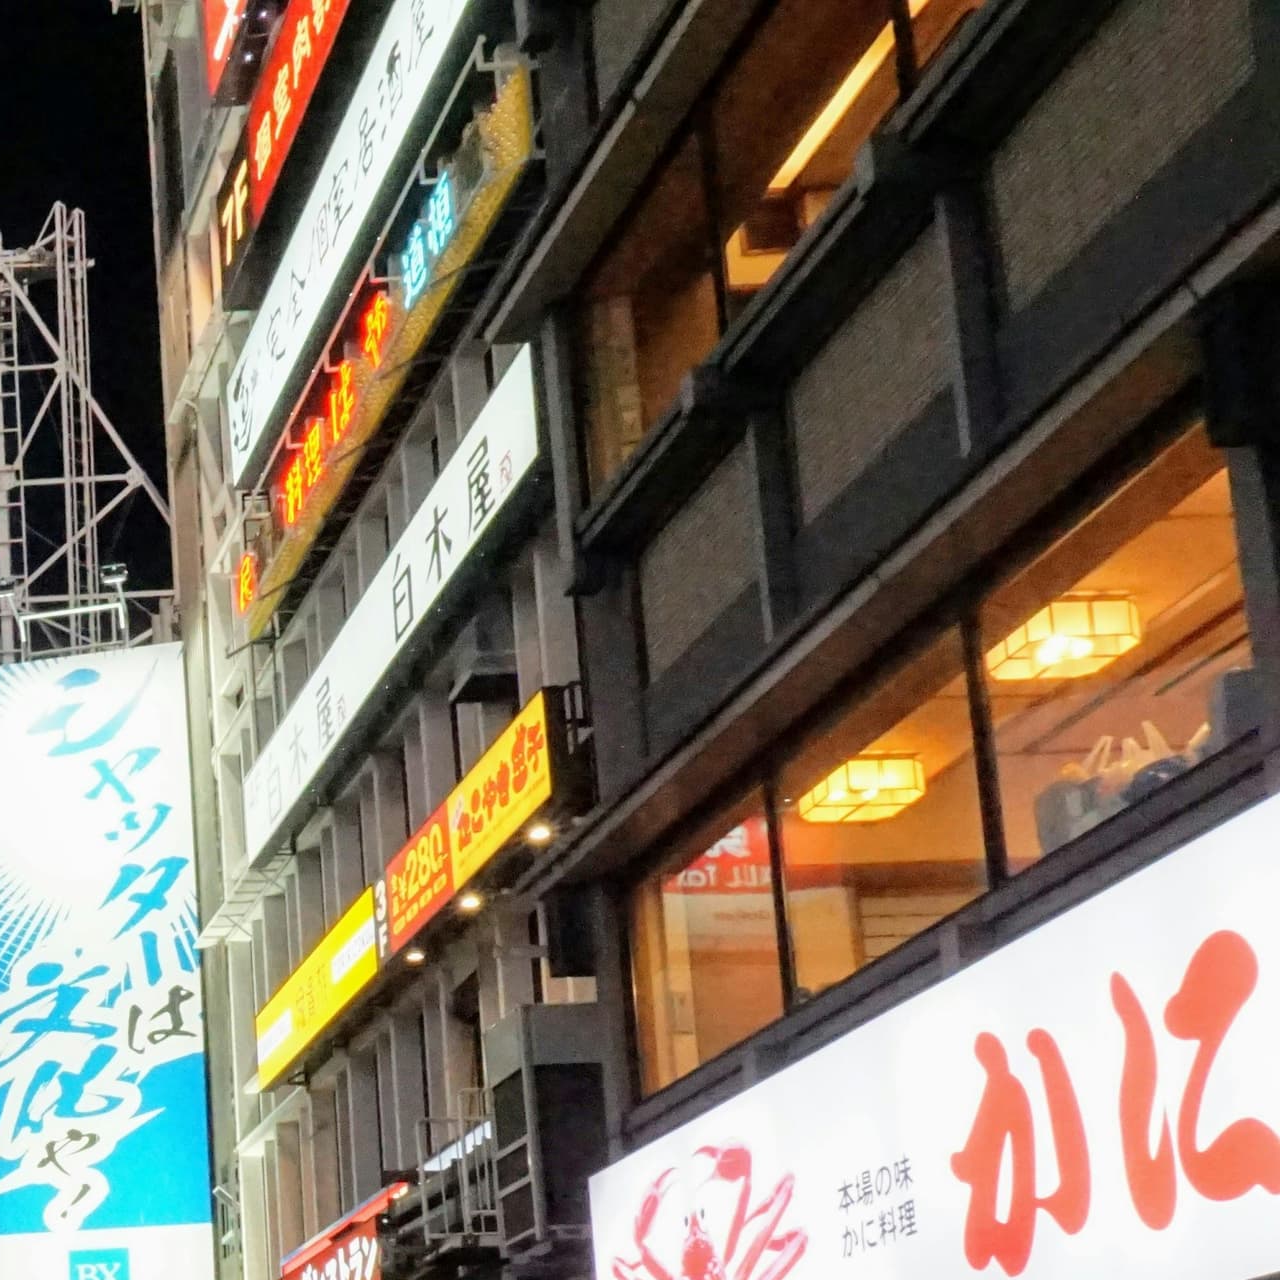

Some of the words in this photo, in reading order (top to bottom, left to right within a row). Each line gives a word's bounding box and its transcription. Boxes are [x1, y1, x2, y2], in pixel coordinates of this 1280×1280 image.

[391, 435, 496, 644] 白木屋
[265, 676, 334, 827] 白木屋
[375, 879, 389, 959] 3F
[950, 928, 1280, 1278] かに
[836, 1156, 915, 1218] 本場の味
[840, 1199, 919, 1260] かに料理
